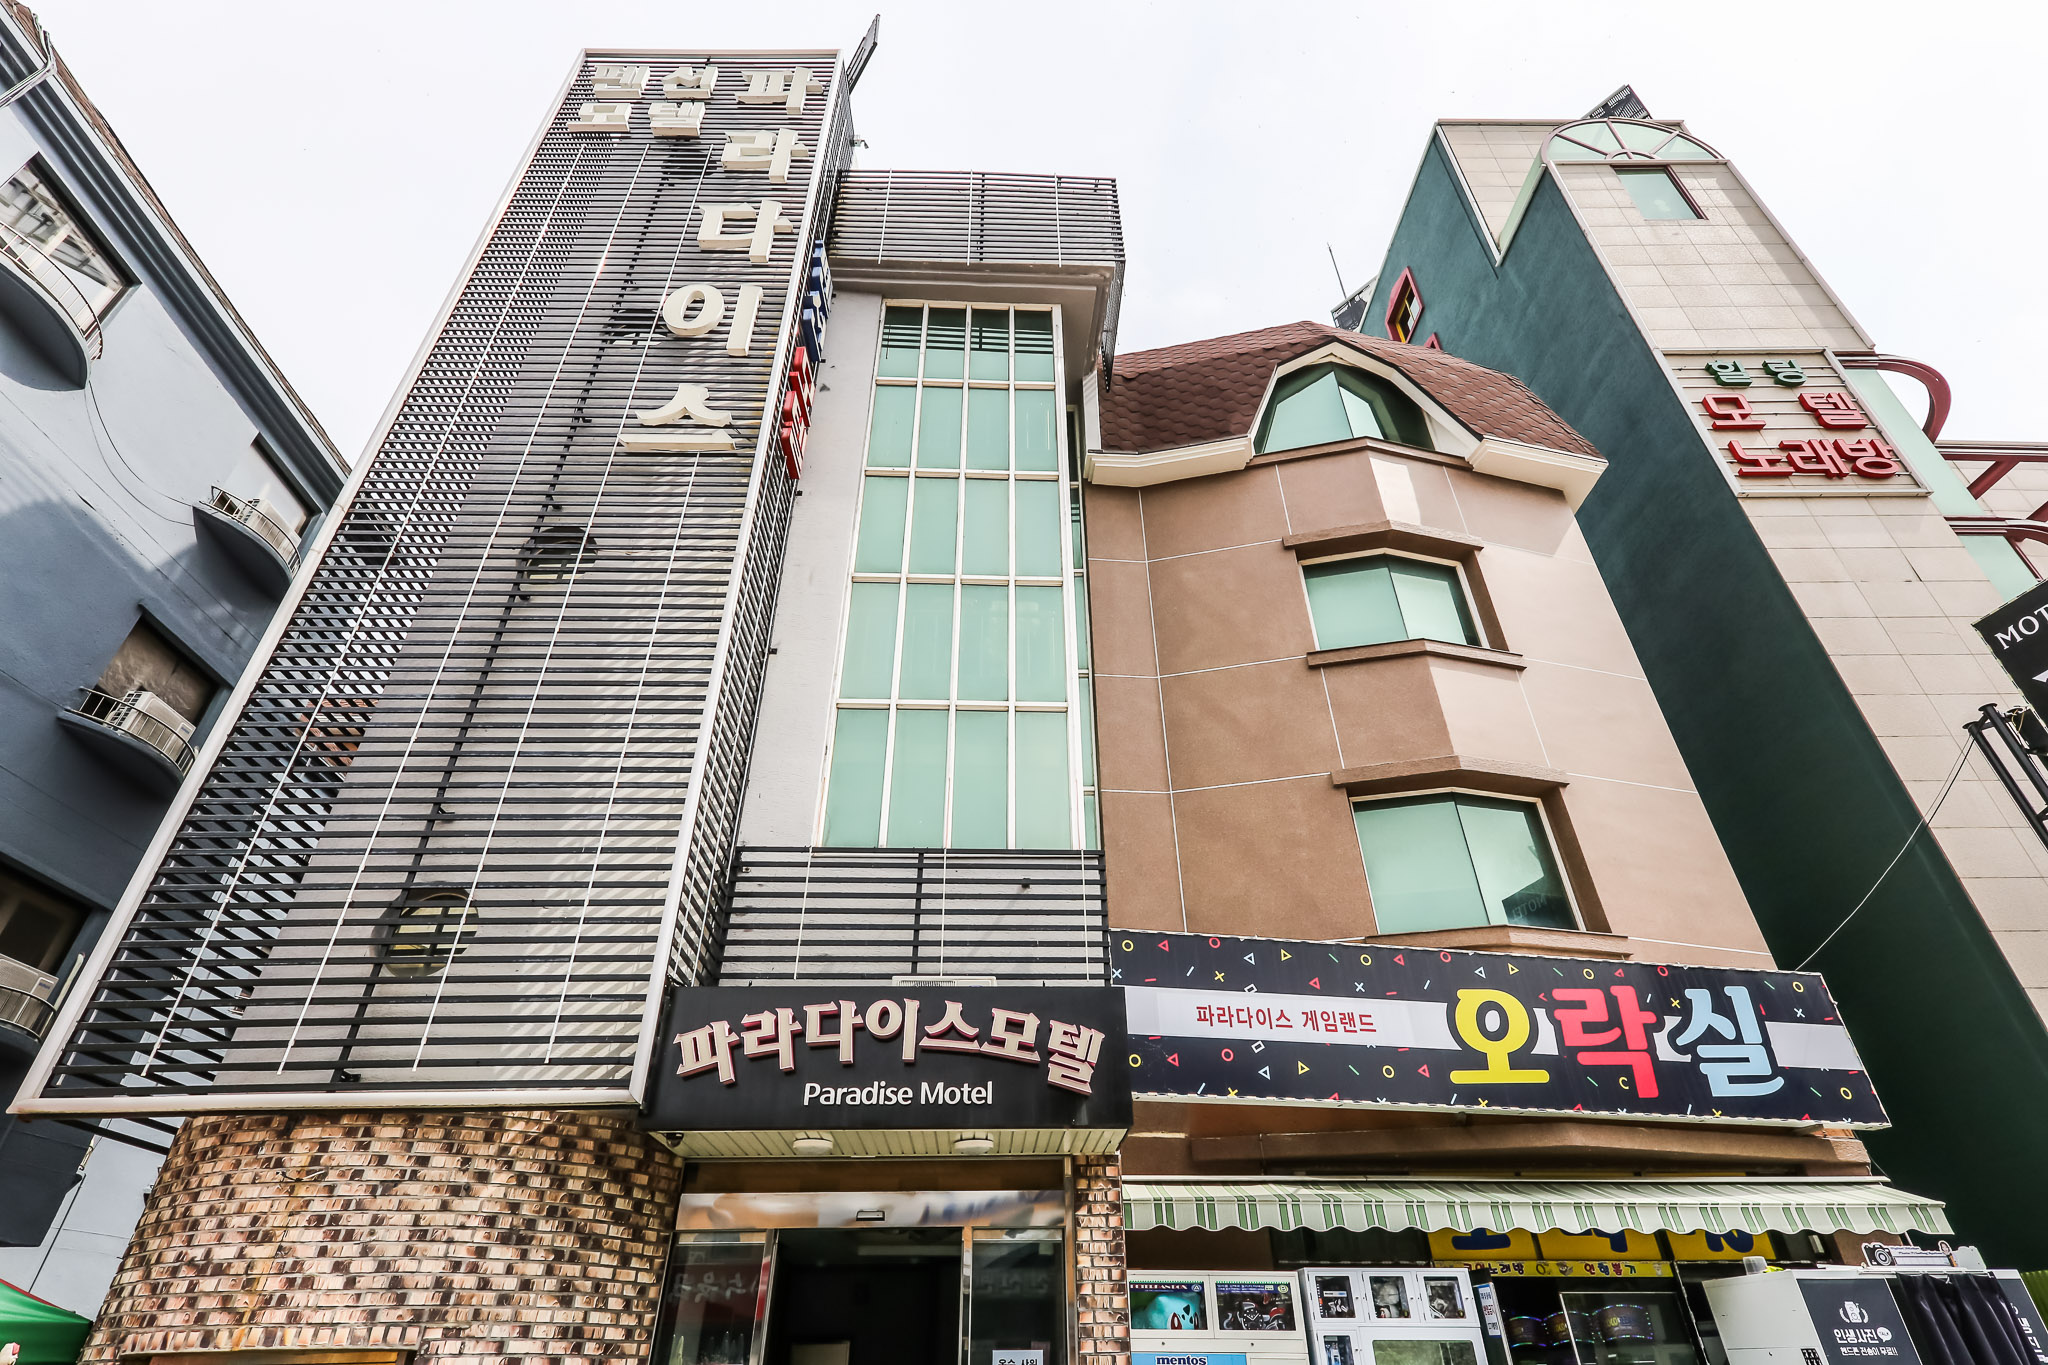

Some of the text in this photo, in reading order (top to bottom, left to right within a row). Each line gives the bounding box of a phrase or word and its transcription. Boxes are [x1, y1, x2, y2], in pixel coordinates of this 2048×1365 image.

[566, 102, 706, 136] 모텔
[617, 66, 824, 451] 파라다이스
[1705, 359, 1807, 386] 힐링
[1702, 393, 1868, 430] 모텔
[1728, 439, 1900, 479] 노래방
[1196, 1005, 1377, 1033] 파라다이스 게임랜드
[674, 997, 1105, 1095] 파라다이스모텔
[1450, 985, 1785, 1099] 오락실
[803, 1081, 993, 1106] Paradise Motel
[1584, 1263, 1637, 1276] 인형뽑기
[1833, 1329, 1879, 1344] 인생사진
[1156, 1354, 1207, 1365] mentos
